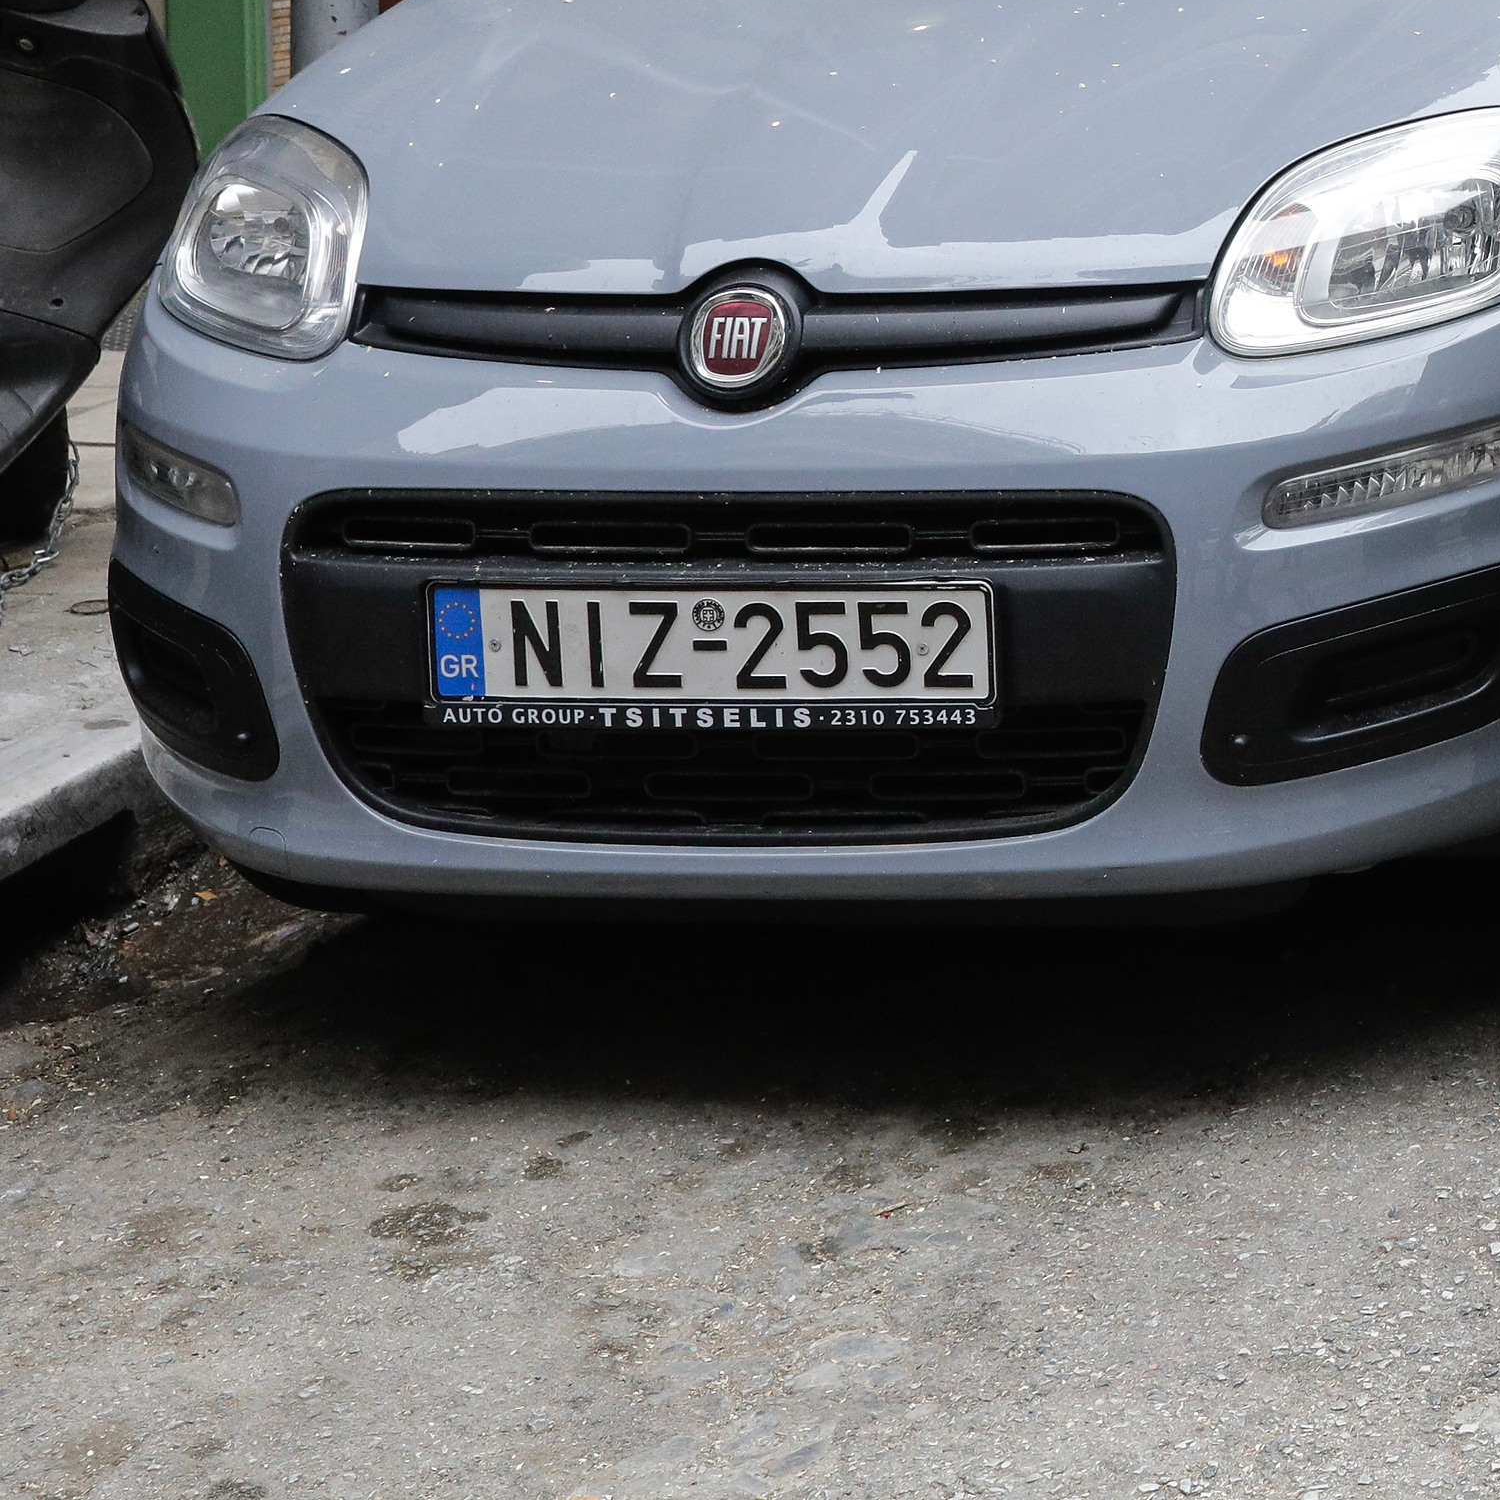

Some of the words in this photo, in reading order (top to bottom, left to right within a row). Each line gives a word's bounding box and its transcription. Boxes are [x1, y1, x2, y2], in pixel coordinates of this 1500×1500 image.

[708, 316, 768, 360] FIAT
[511, 600, 974, 690] NIZ-2552
[440, 654, 479, 679] GR
[443, 707, 503, 725] AUTO
[512, 708, 585, 725] GROUP
[599, 706, 812, 729] TSITSELIS
[830, 708, 885, 726] 2310
[895, 708, 977, 726] 753443
